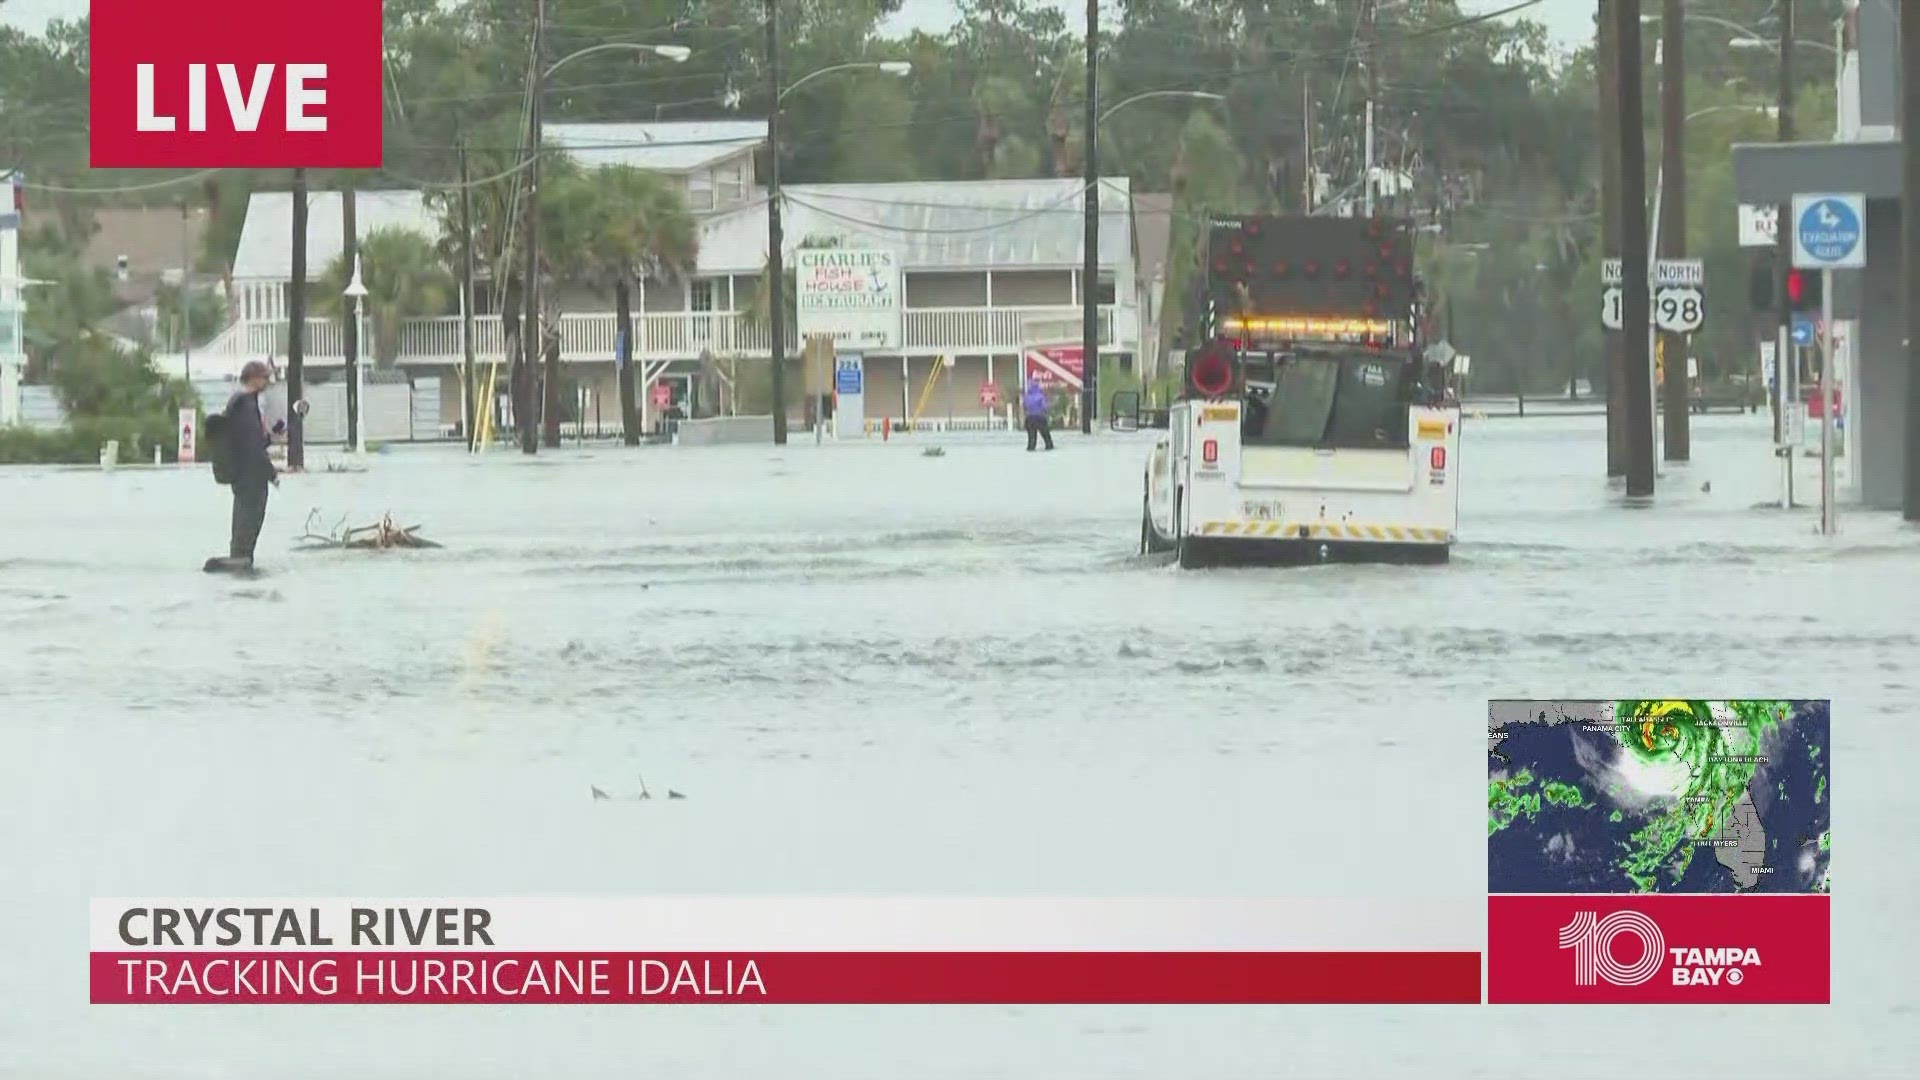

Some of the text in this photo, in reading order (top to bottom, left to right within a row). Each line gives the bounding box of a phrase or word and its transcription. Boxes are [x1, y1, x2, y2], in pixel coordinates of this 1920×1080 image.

[1802, 231, 1857, 243] EVACUATION
[802, 252, 892, 267] CHARLIE'S
[815, 267, 853, 279] FISH
[1659, 264, 1700, 279] NORTH
[806, 280, 864, 292] HOUSE
[1612, 295, 1620, 321] 1
[1661, 297, 1698, 323] 98
[839, 360, 859, 370] 224
